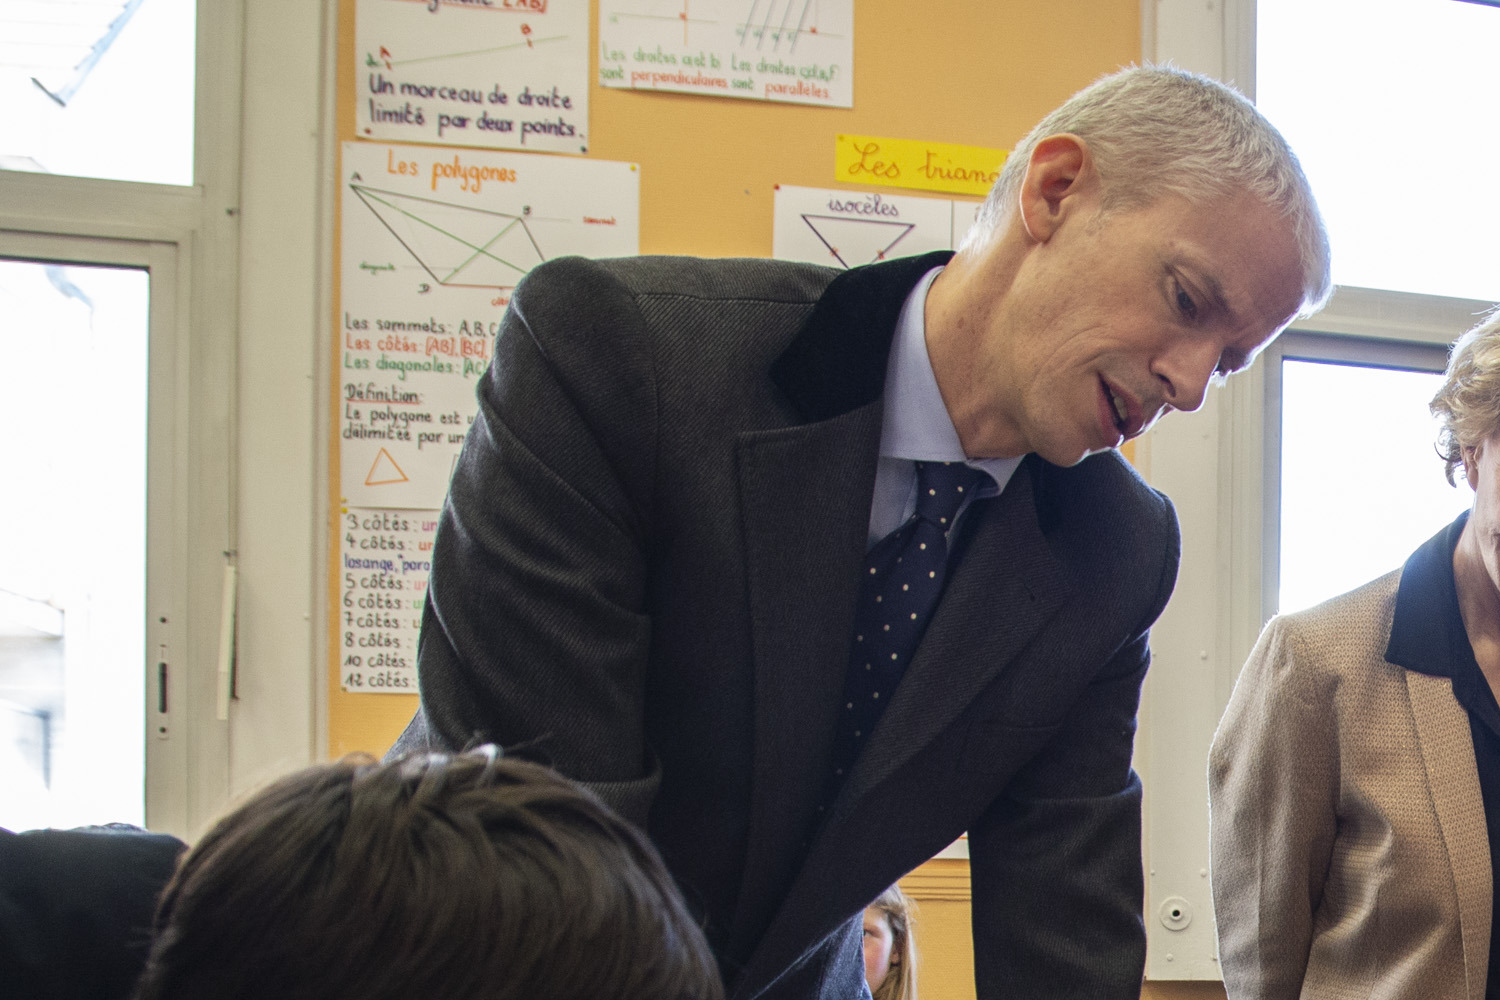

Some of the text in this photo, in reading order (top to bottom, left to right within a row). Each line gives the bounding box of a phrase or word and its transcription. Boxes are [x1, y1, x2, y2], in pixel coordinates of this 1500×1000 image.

[602, 41, 625, 62] Les
[731, 52, 751, 72] Les
[630, 71, 729, 90] perpendiculaires
[369, 73, 572, 109] Un morceau de droite
[368, 98, 584, 145] limité par deux points.
[848, 142, 900, 176] Les
[388, 149, 517, 194] Les polygones
[826, 194, 899, 217] isocèles
[345, 312, 368, 331] Les
[346, 333, 370, 351] Les
[344, 352, 370, 370] Les
[345, 403, 361, 420] Le
[370, 406, 432, 430] polygone
[440, 411, 461, 425] est
[343, 422, 411, 442] délimitée
[418, 431, 442, 450] par
[347, 514, 359, 530] 3
[345, 533, 356, 548] 4
[344, 553, 399, 576] losange,
[345, 573, 356, 589] 5
[343, 591, 353, 608] 6
[344, 611, 354, 626] 7
[344, 631, 354, 647] 8
[344, 655, 361, 667] 10
[345, 673, 363, 687] 12
